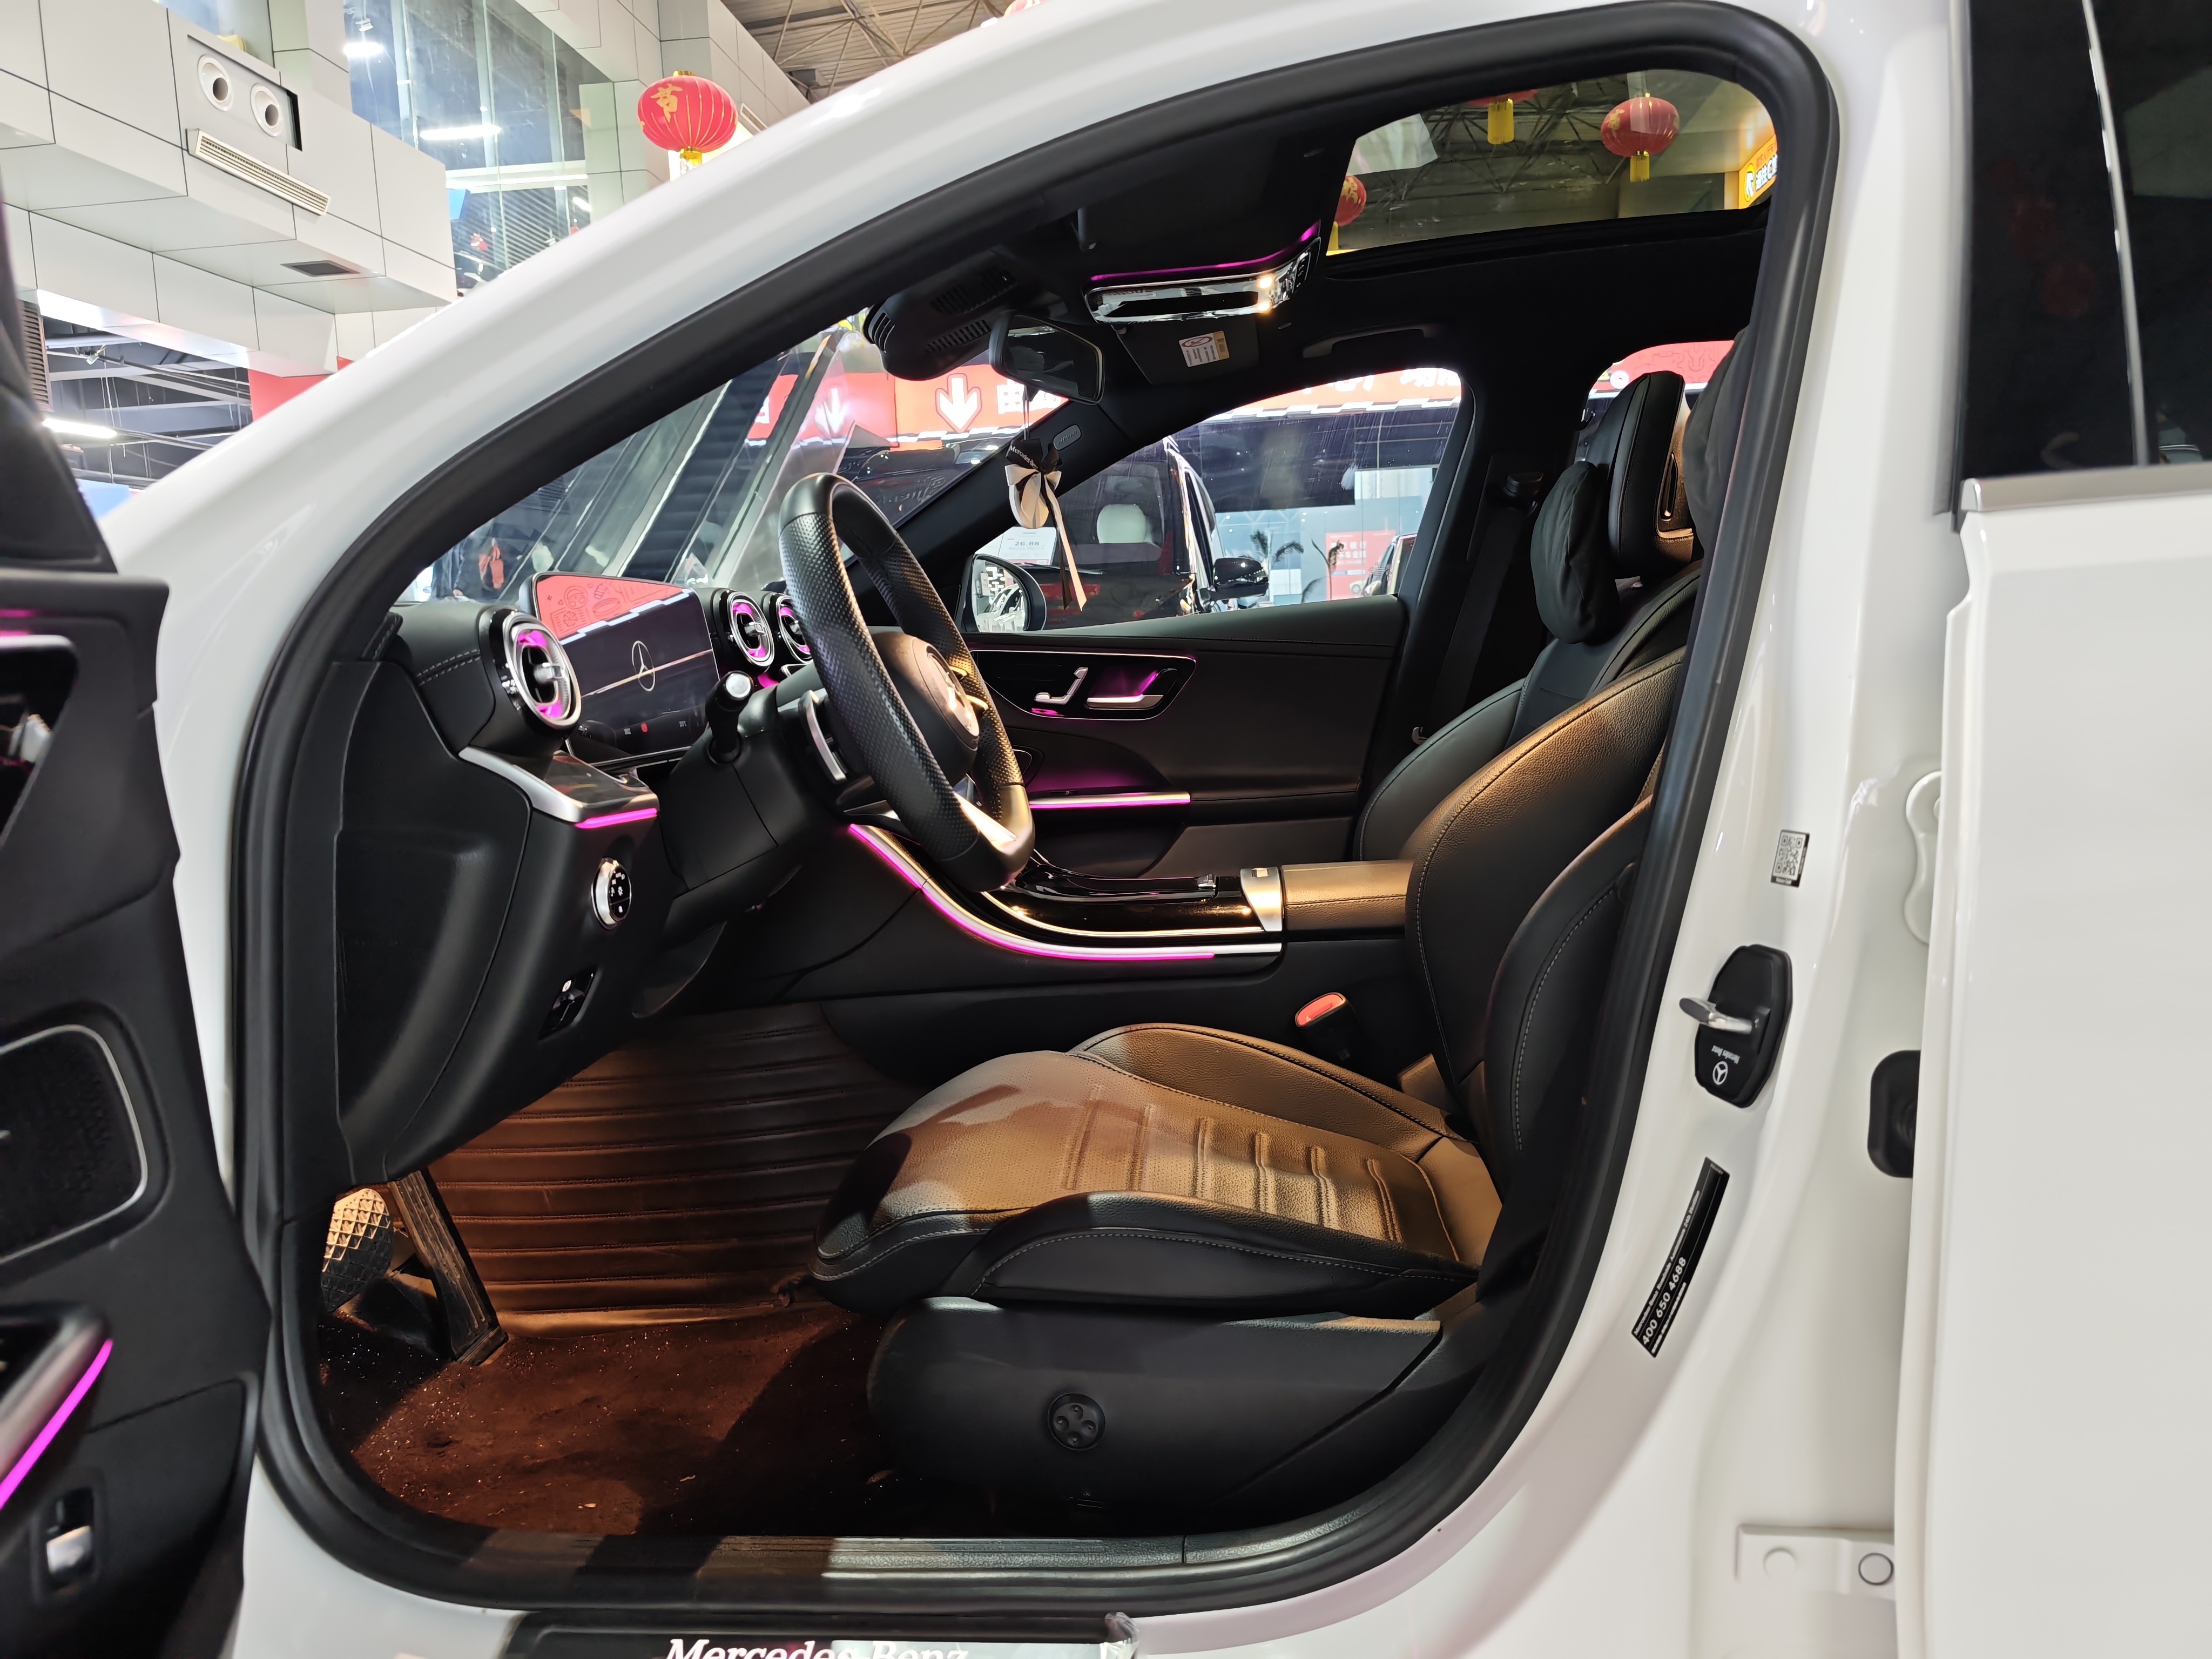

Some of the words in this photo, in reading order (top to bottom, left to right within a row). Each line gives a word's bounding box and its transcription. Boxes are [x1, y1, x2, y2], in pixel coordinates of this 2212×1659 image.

[1643, 1319, 1657, 1345] 400
[1656, 1292, 1670, 1318] 650
[1669, 1257, 1685, 1290] 4688
